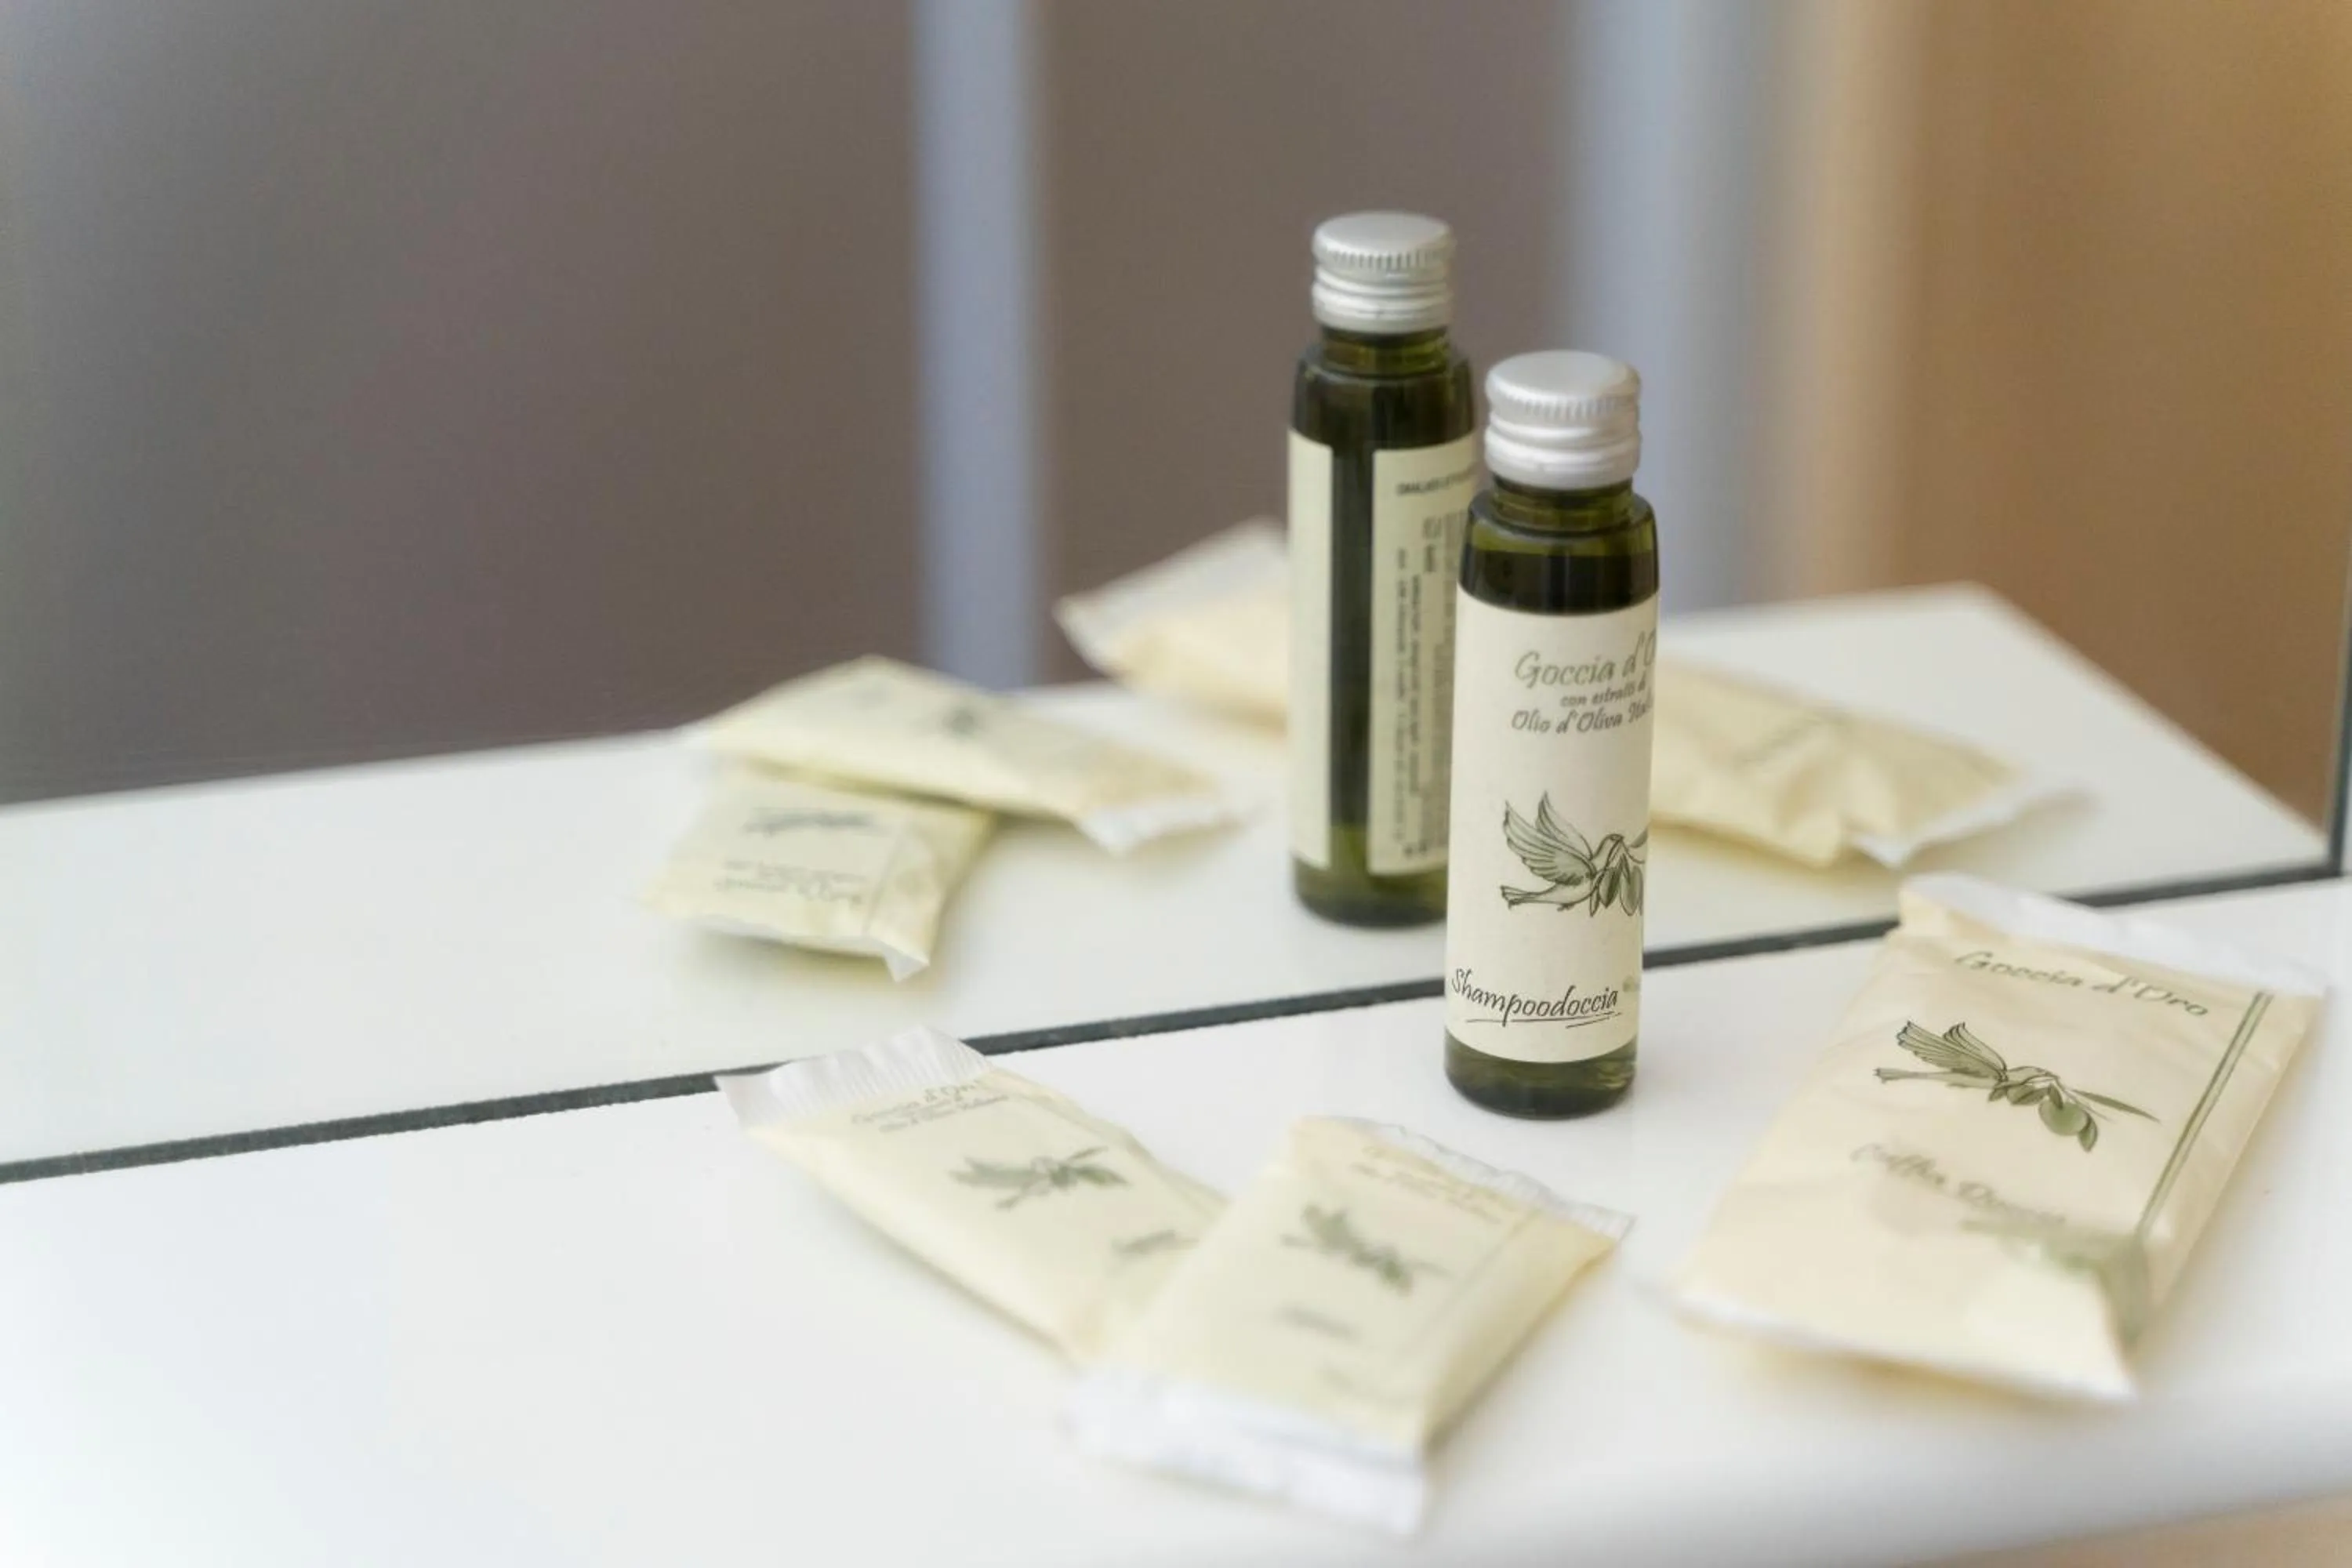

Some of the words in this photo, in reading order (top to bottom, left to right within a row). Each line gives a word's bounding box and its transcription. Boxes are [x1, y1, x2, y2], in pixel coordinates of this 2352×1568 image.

[1514, 651, 1616, 688] Goccia
[1559, 694, 1588, 706] con
[1511, 709, 1551, 733] Olio
[1555, 707, 1624, 734] d'Oliva
[1451, 967, 1618, 1027] Shampoodoccia
[2089, 975, 2209, 1017] d'Oro
